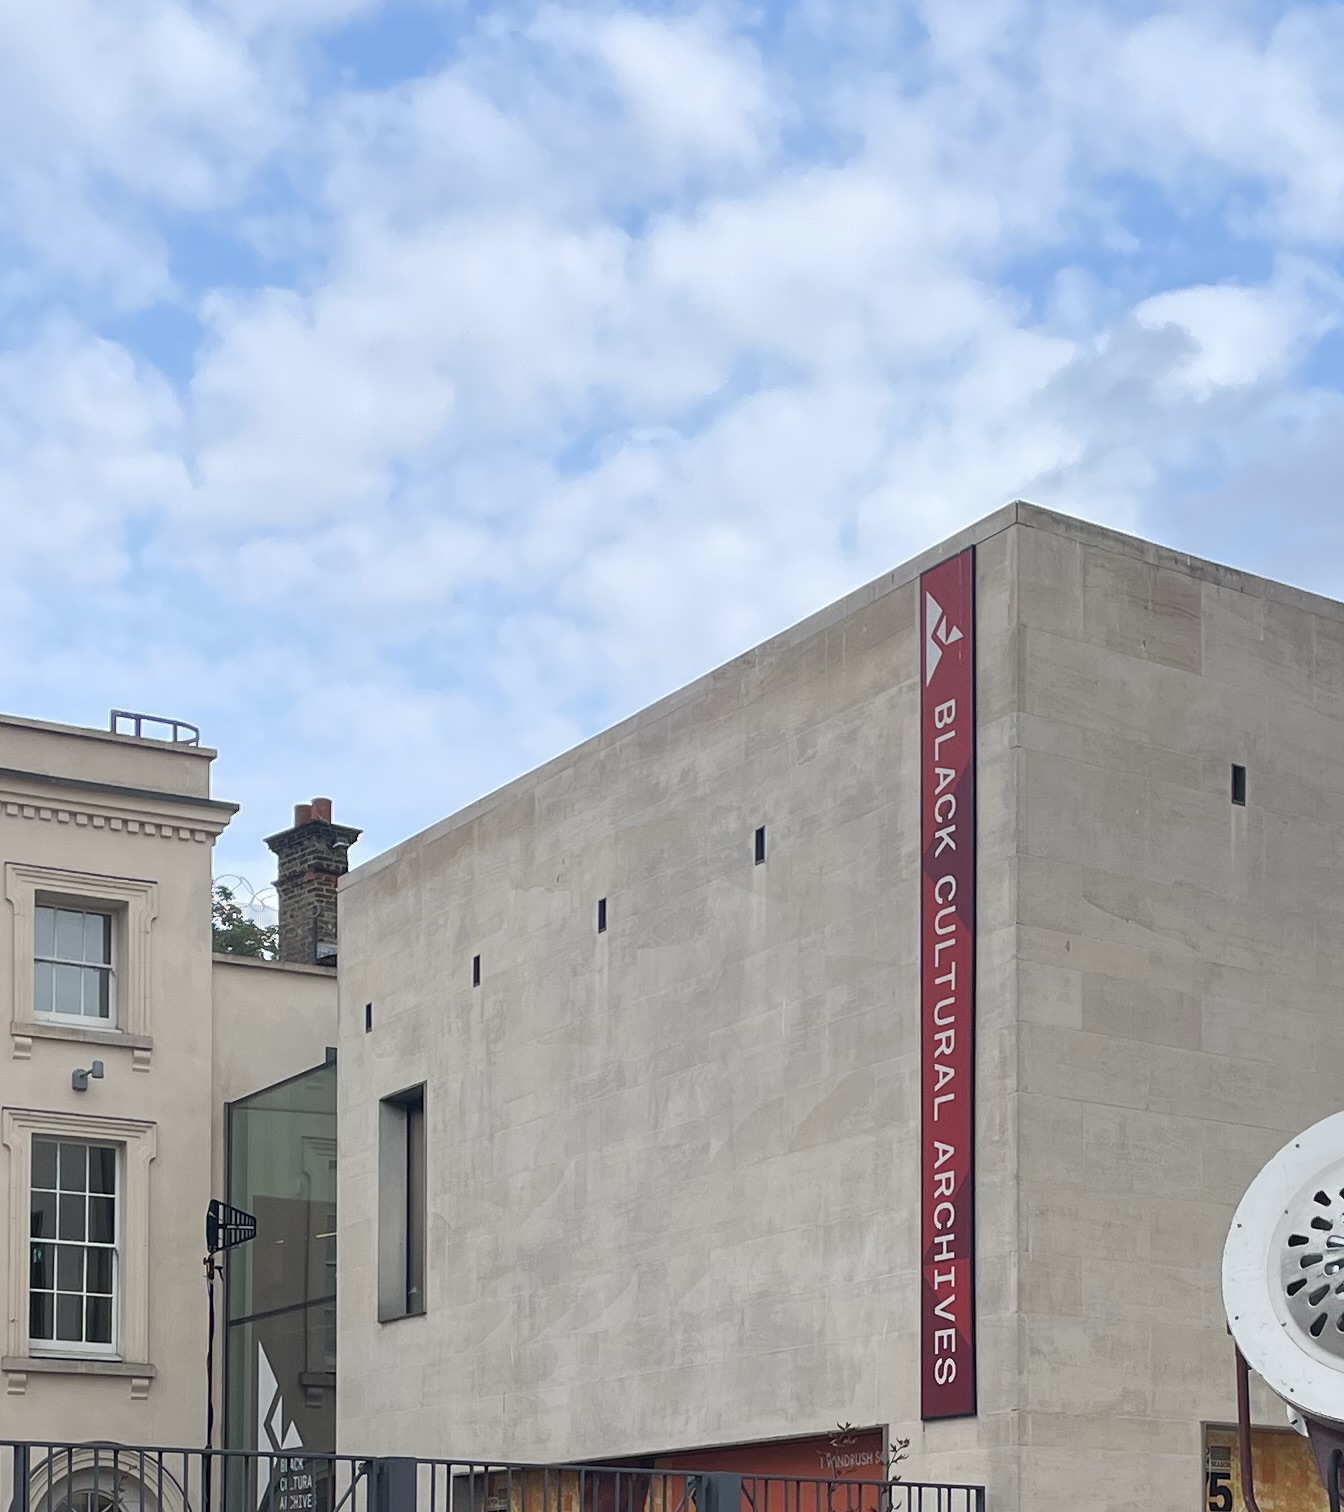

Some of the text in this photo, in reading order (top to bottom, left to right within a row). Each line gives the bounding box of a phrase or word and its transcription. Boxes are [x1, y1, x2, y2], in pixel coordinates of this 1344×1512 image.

[933, 699, 957, 1386] BLACK CULTURAL ARCHIVES
